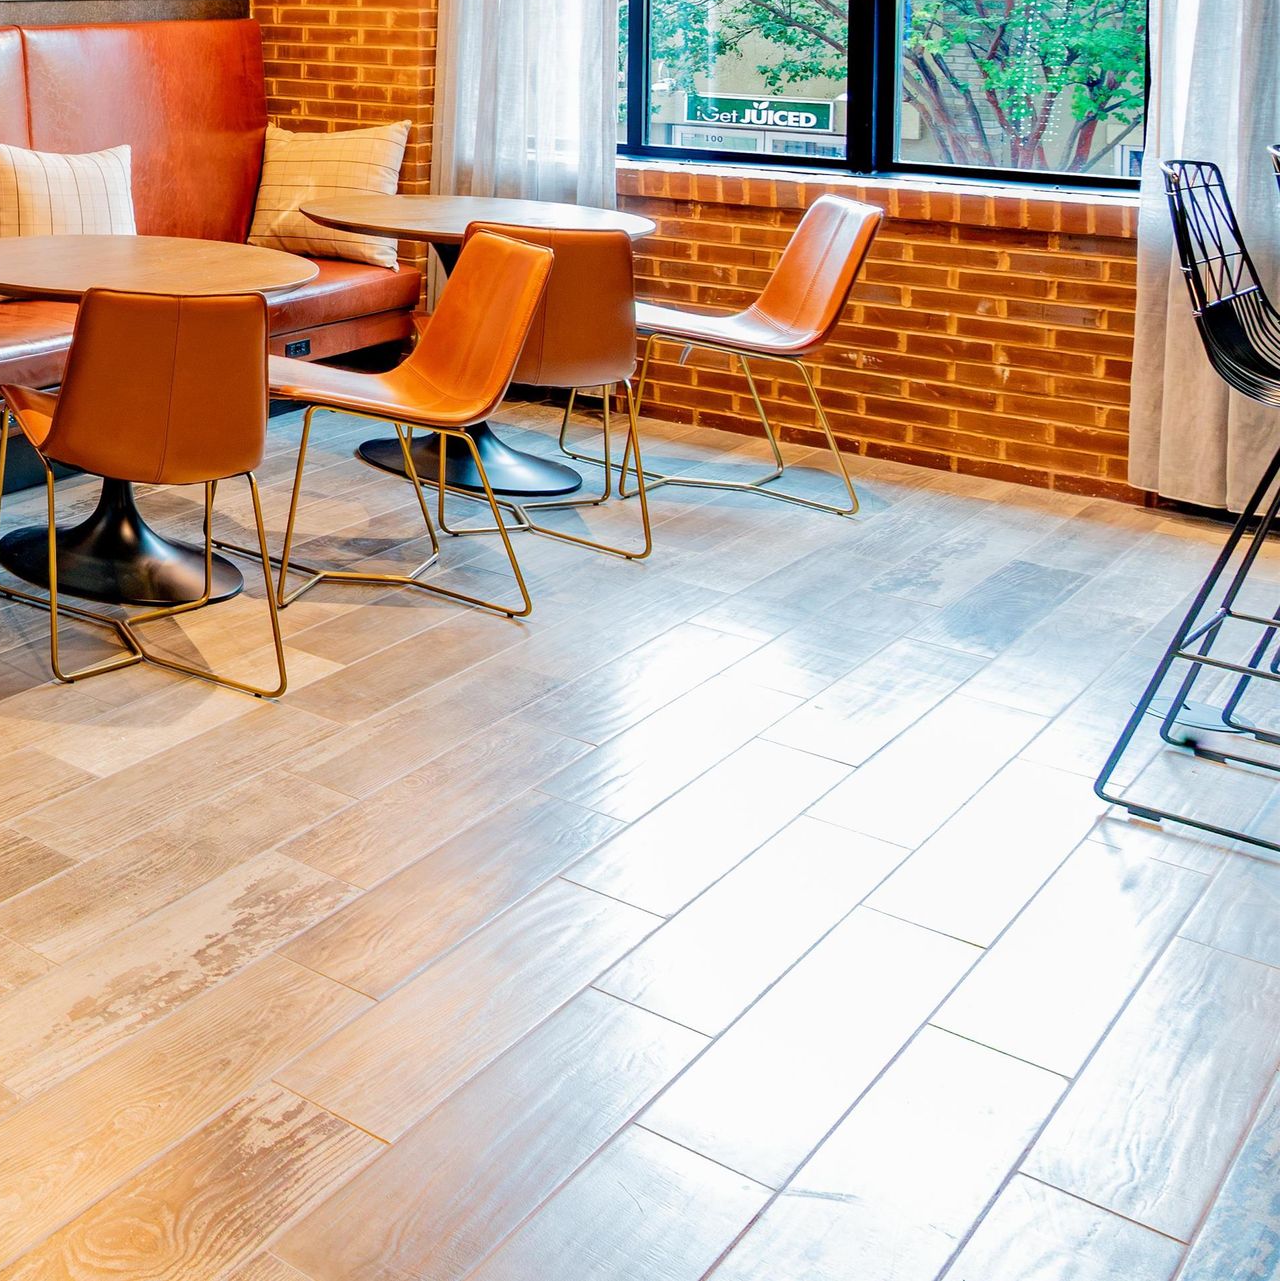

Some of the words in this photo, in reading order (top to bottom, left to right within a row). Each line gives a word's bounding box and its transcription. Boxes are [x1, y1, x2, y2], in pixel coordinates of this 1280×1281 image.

[696, 106, 739, 123] iGet
[740, 107, 817, 127] JUICED
[704, 134, 723, 143] 100
